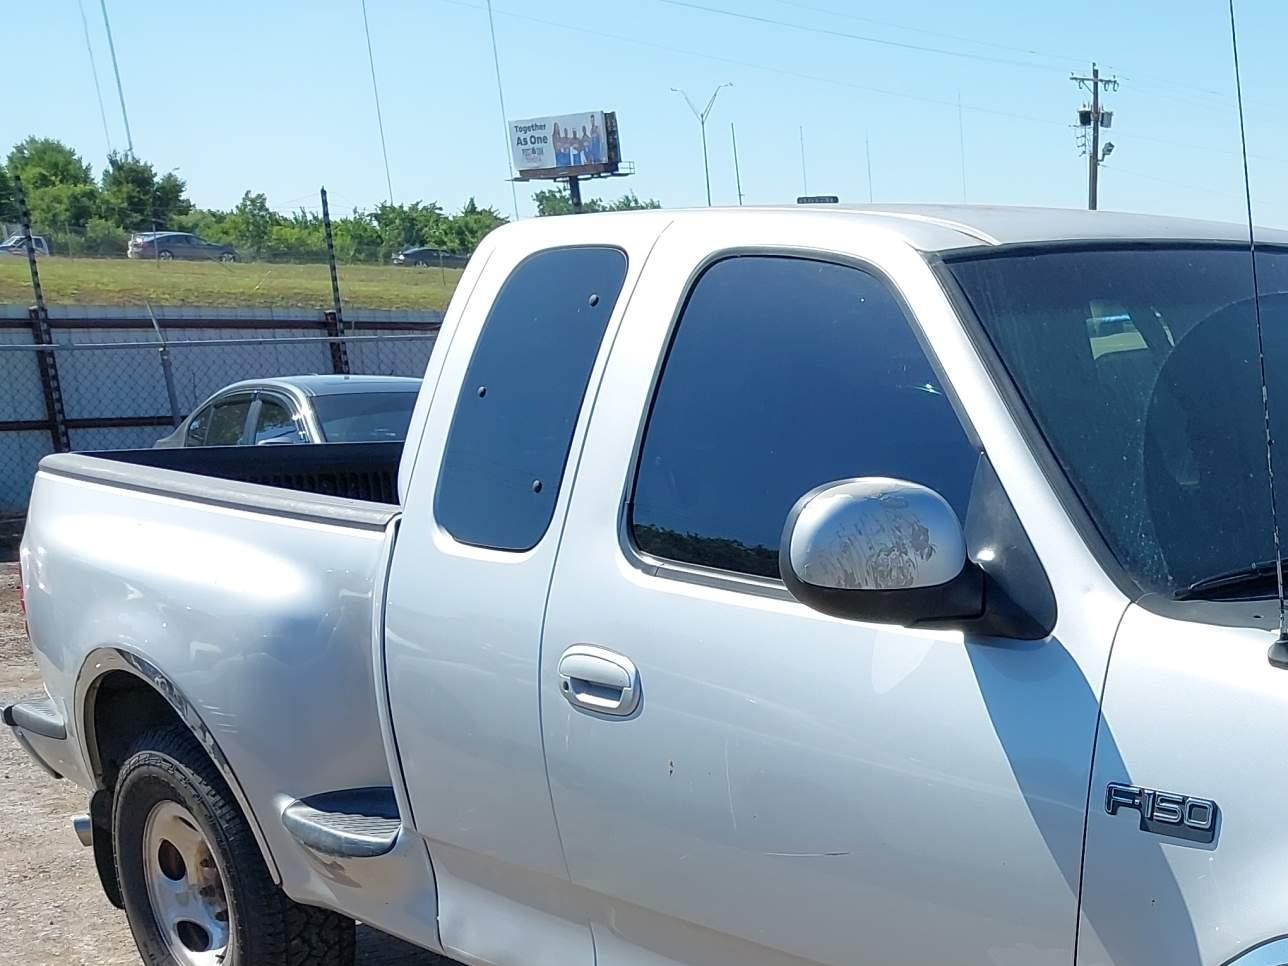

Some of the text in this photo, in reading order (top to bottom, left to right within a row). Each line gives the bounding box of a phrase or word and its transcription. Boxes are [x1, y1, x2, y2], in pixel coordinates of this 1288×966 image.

[514, 123, 546, 135] Together
[516, 135, 549, 146] As One
